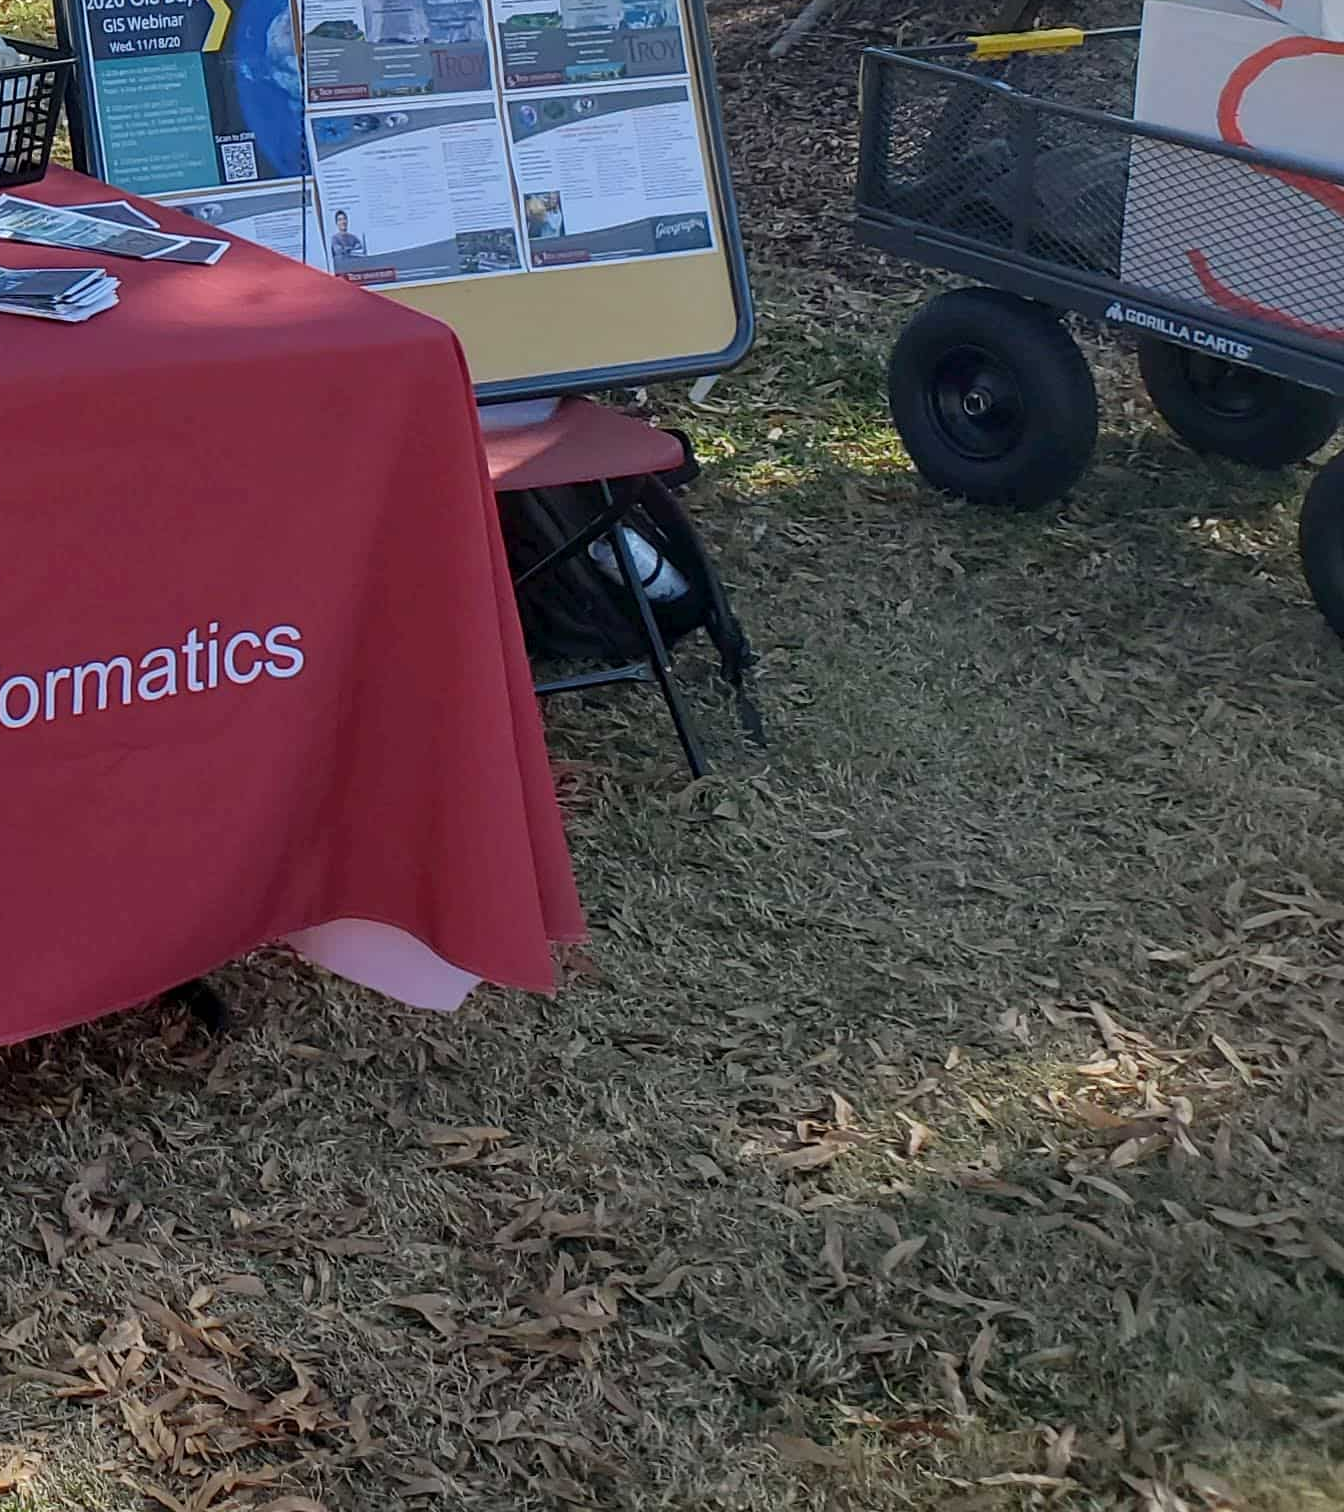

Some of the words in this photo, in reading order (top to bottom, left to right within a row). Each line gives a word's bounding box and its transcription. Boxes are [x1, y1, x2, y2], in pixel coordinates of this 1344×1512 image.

[103, 18, 125, 33] GIS
[126, 14, 184, 31] Webinar
[136, 36, 181, 52] 11/18/20
[623, 34, 678, 64] TROY
[1125, 309, 1190, 341] GORILLA
[1192, 331, 1250, 360] CARTS
